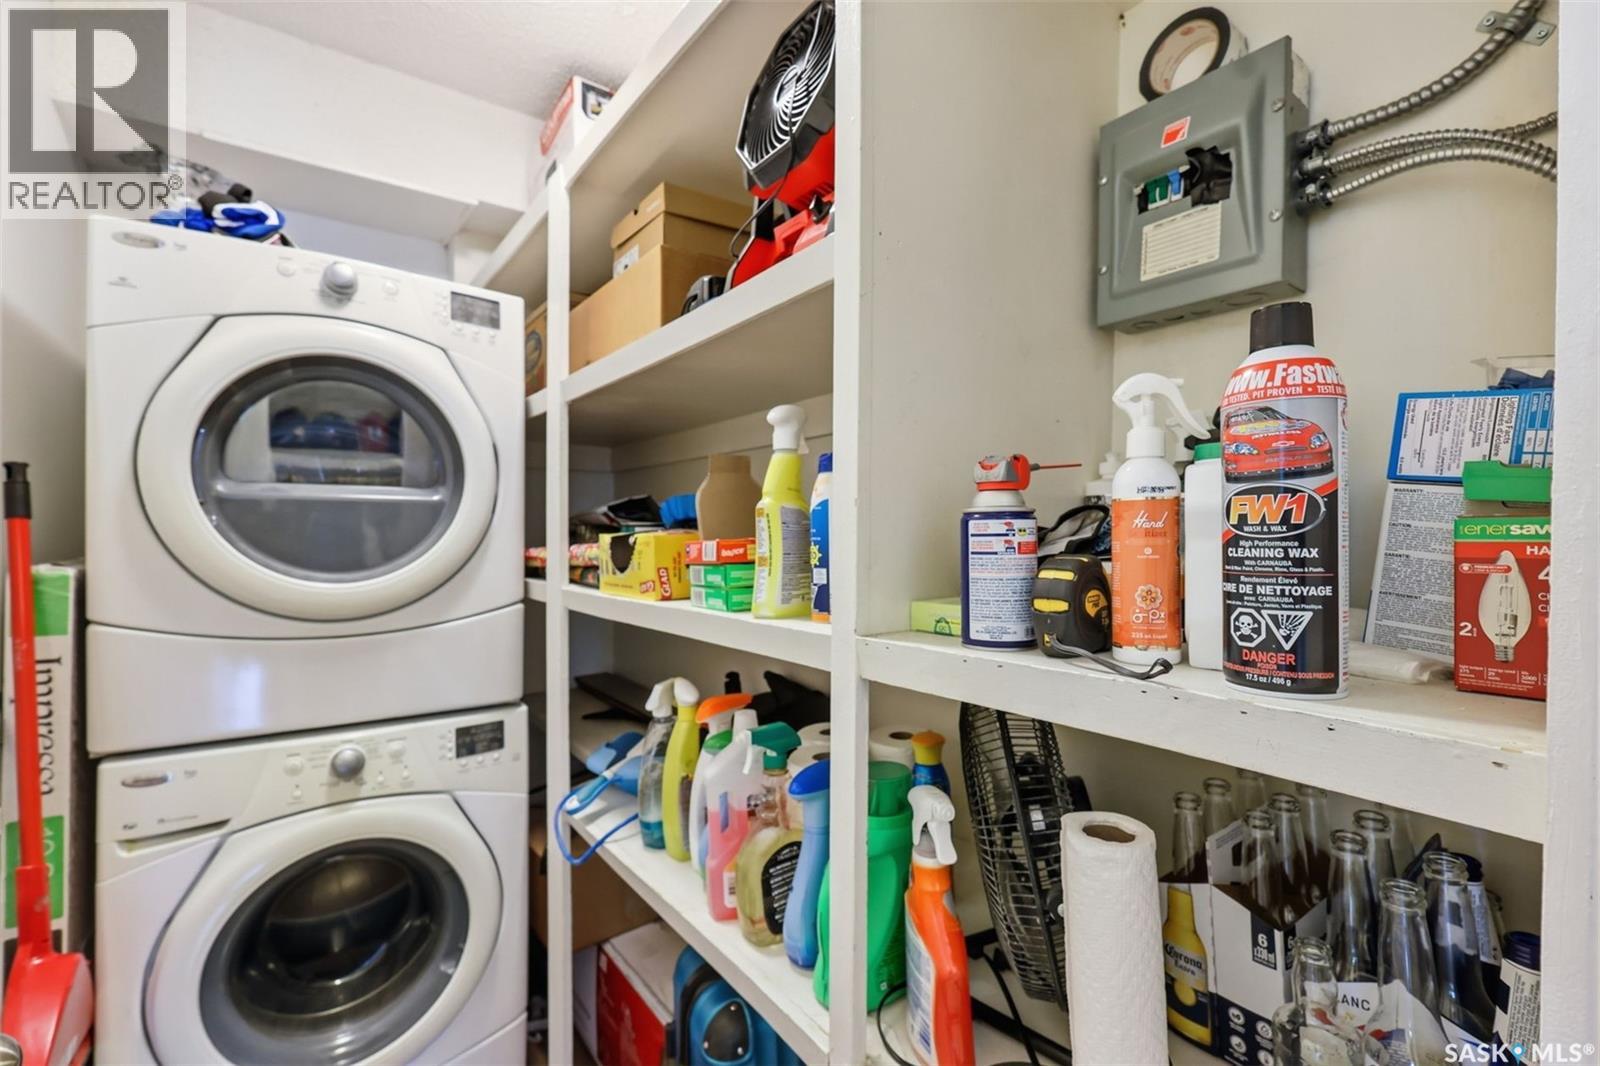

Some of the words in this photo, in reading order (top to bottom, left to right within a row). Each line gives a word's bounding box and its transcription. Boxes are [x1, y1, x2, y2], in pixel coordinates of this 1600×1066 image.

[1253, 391, 1265, 400] PIT
[1266, 385, 1303, 398] PROVEN
[1502, 425, 1515, 445] Facts
[1229, 492, 1309, 525] FW1
[1132, 510, 1169, 529] Hand
[1240, 540, 1253, 548] High
[1227, 548, 1285, 558] CLEANING
[1287, 548, 1319, 558] WAX
[1240, 575, 1277, 583] Rendement
[1278, 576, 1299, 584] Élevé
[1239, 583, 1253, 594] DE
[1256, 585, 1333, 597] NETTOYAGE
[1459, 621, 1473, 637] 2
[1242, 649, 1297, 665] DANGER
[1257, 932, 1269, 948] 6
[1165, 942, 1203, 970] Corona
